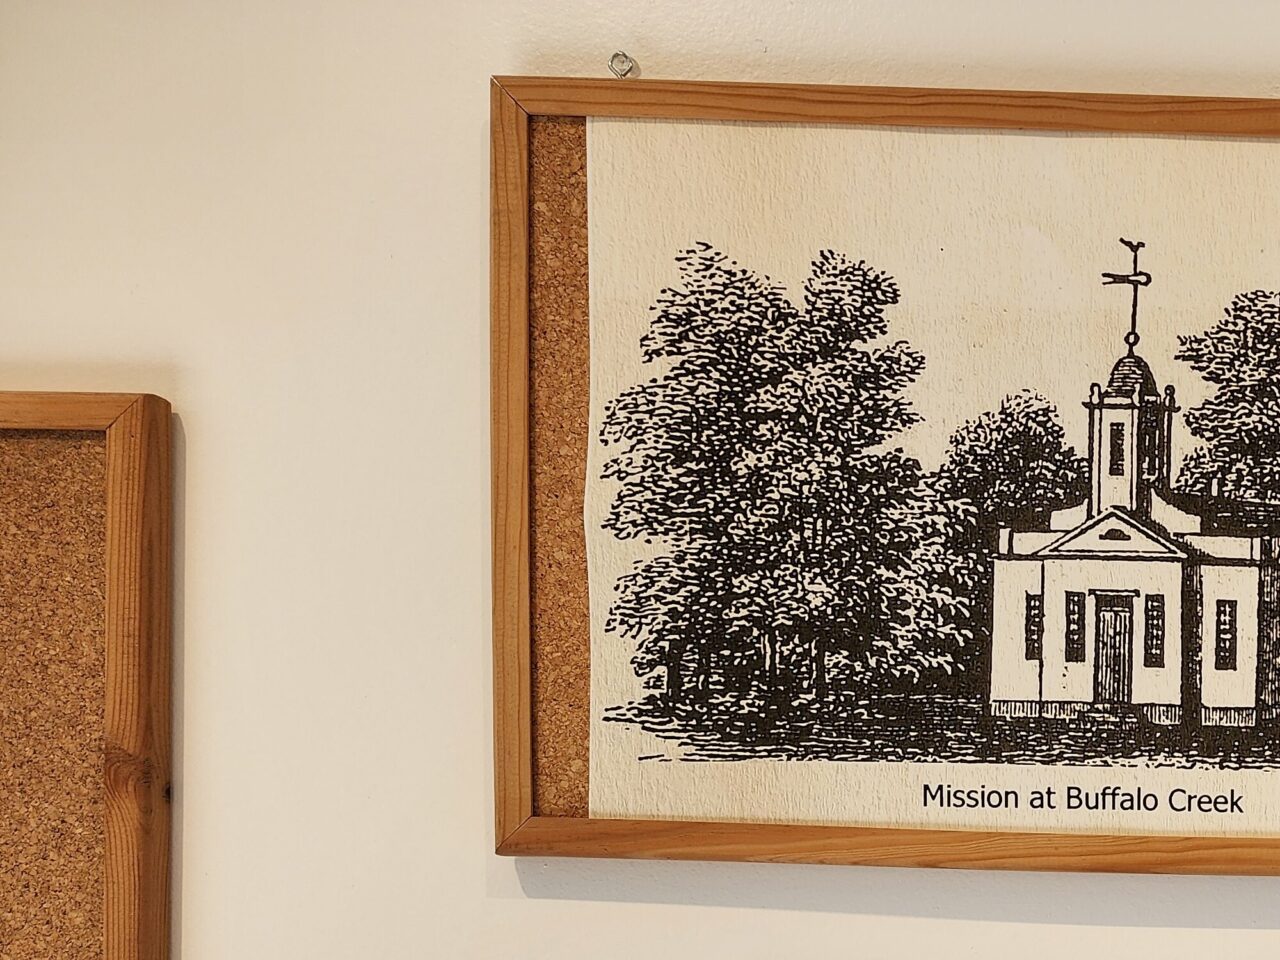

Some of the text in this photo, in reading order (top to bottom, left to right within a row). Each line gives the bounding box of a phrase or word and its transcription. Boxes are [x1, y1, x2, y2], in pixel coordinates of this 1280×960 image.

[922, 784, 1244, 813] Mission at Buffalo Creek
